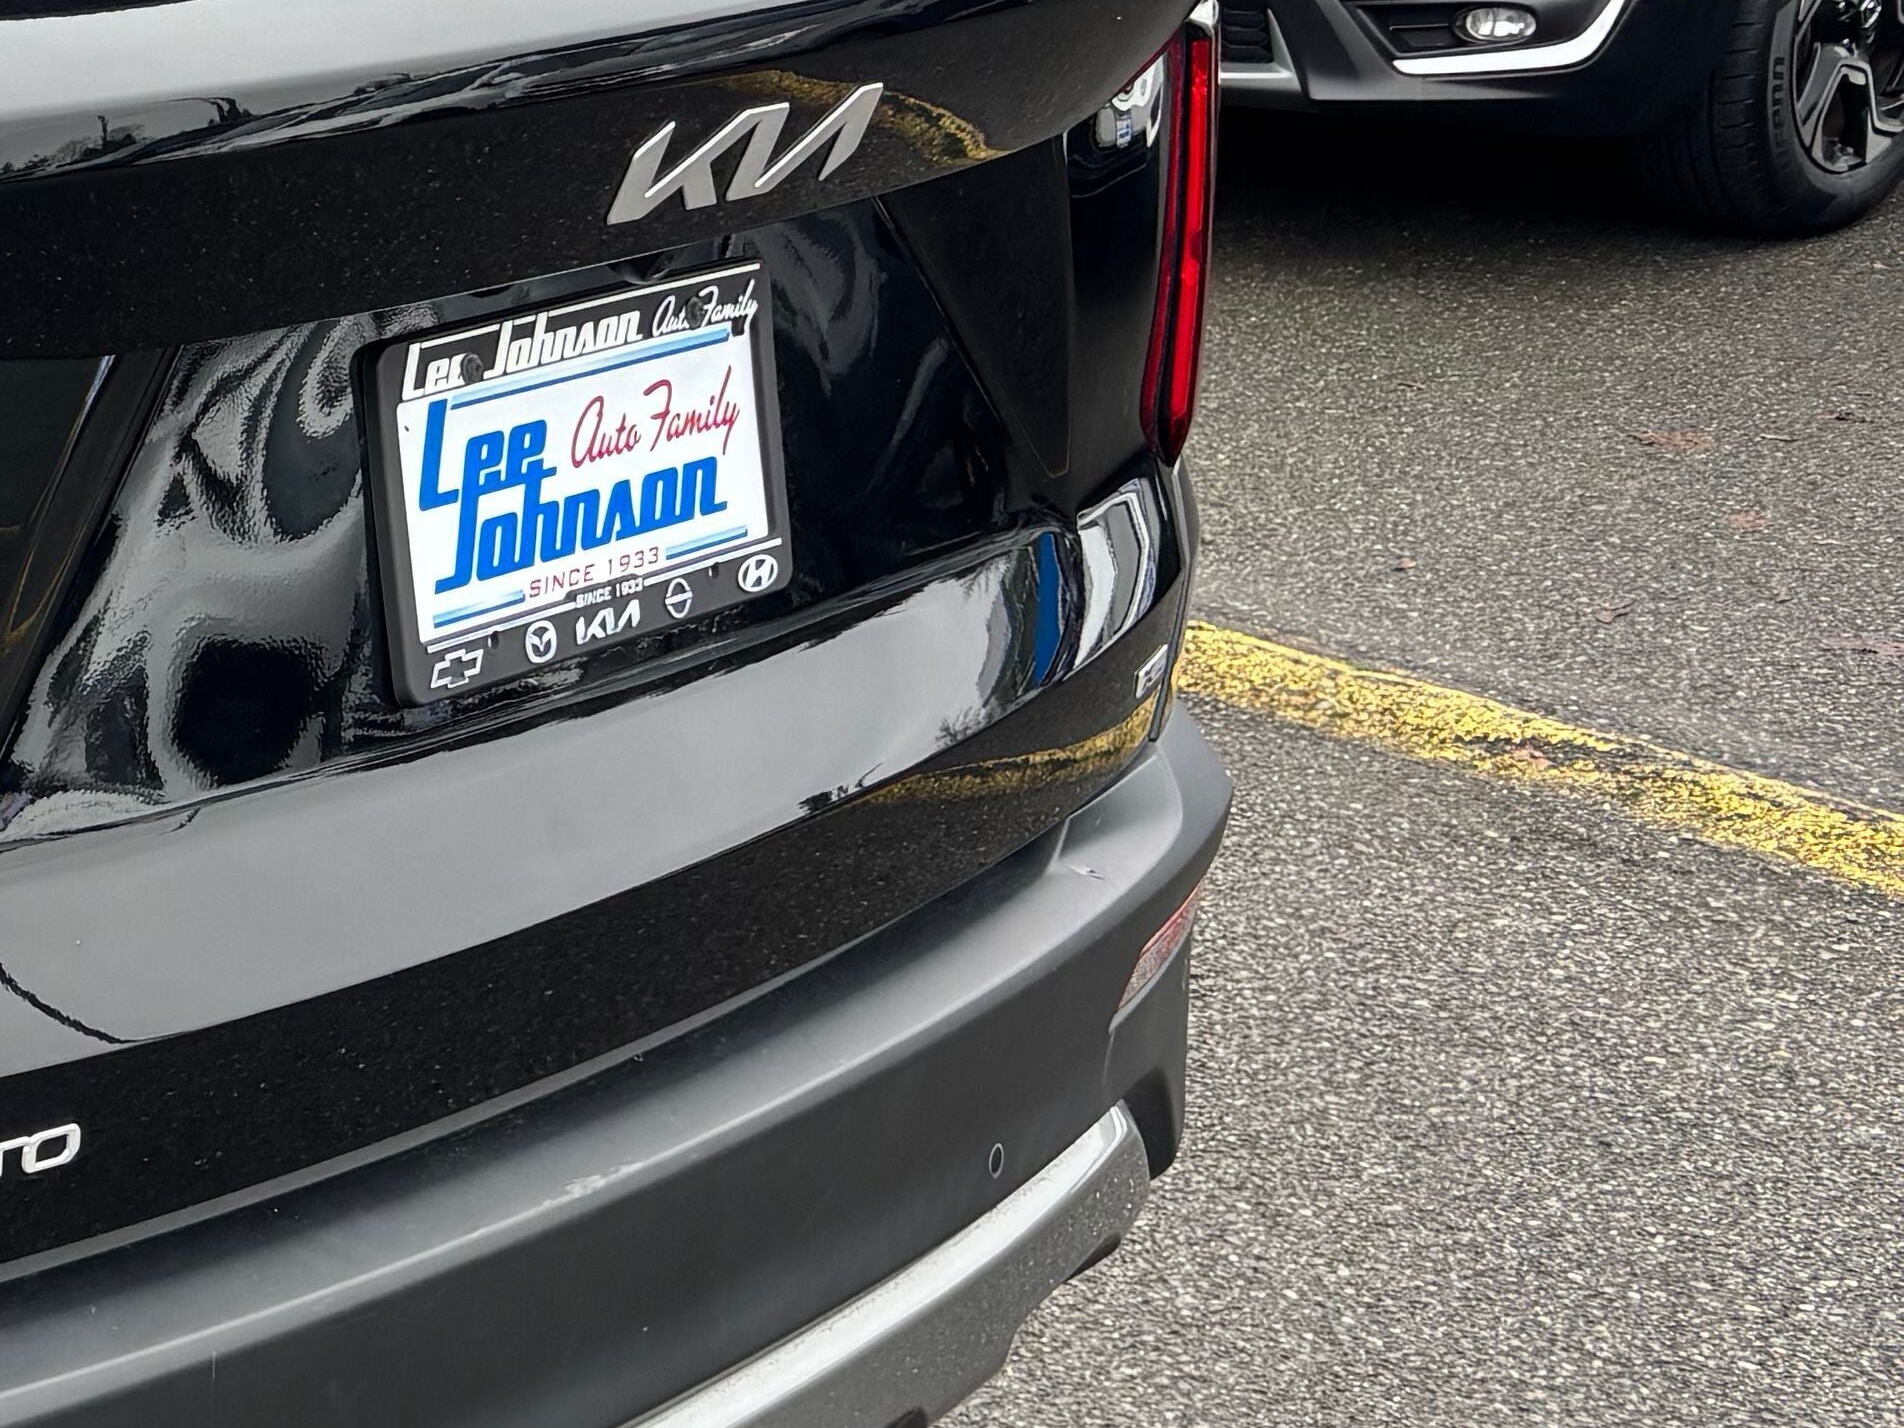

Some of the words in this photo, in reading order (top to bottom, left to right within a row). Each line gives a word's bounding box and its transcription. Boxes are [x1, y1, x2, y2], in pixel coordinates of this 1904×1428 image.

[483, 311, 644, 381] Johnson
[697, 278, 758, 336] Family
[419, 398, 557, 511] Lee
[571, 395, 642, 469] Auto
[643, 364, 740, 456] Family
[435, 456, 728, 595] Johnson
[529, 563, 596, 599] SINCE
[608, 546, 660, 576] 1933
[575, 585, 613, 609] SINCE
[615, 575, 645, 598] 1933
